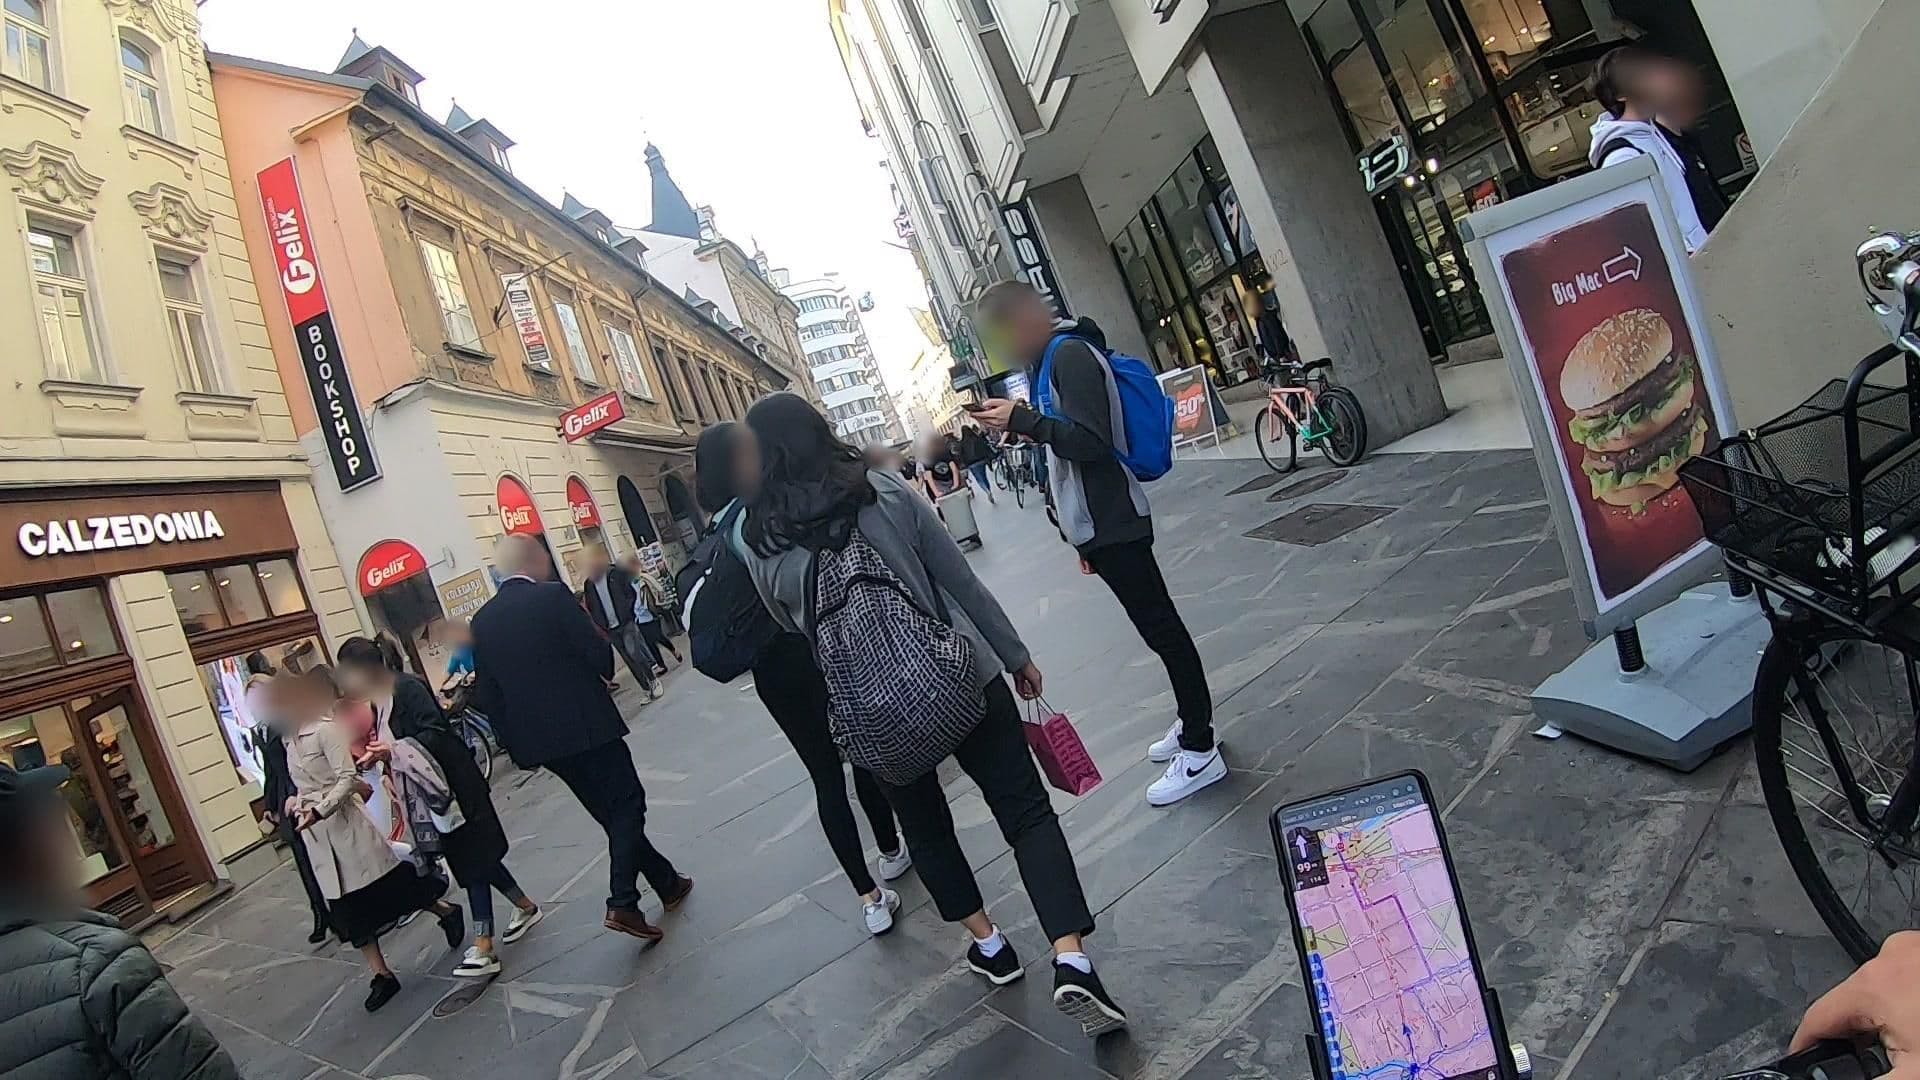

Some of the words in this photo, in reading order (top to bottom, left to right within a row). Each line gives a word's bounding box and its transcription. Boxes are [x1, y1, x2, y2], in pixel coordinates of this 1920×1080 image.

[275, 208, 316, 294] Felix
[1551, 282, 1577, 306] Big
[1575, 271, 1603, 296] Mac
[308, 325, 360, 476] BOOKSHOP
[565, 405, 609, 435] Felix
[18, 510, 225, 557] CALZEDONIA
[500, 505, 531, 531] Felix
[367, 558, 405, 587] Felix
[1296, 862, 1312, 873] 99
